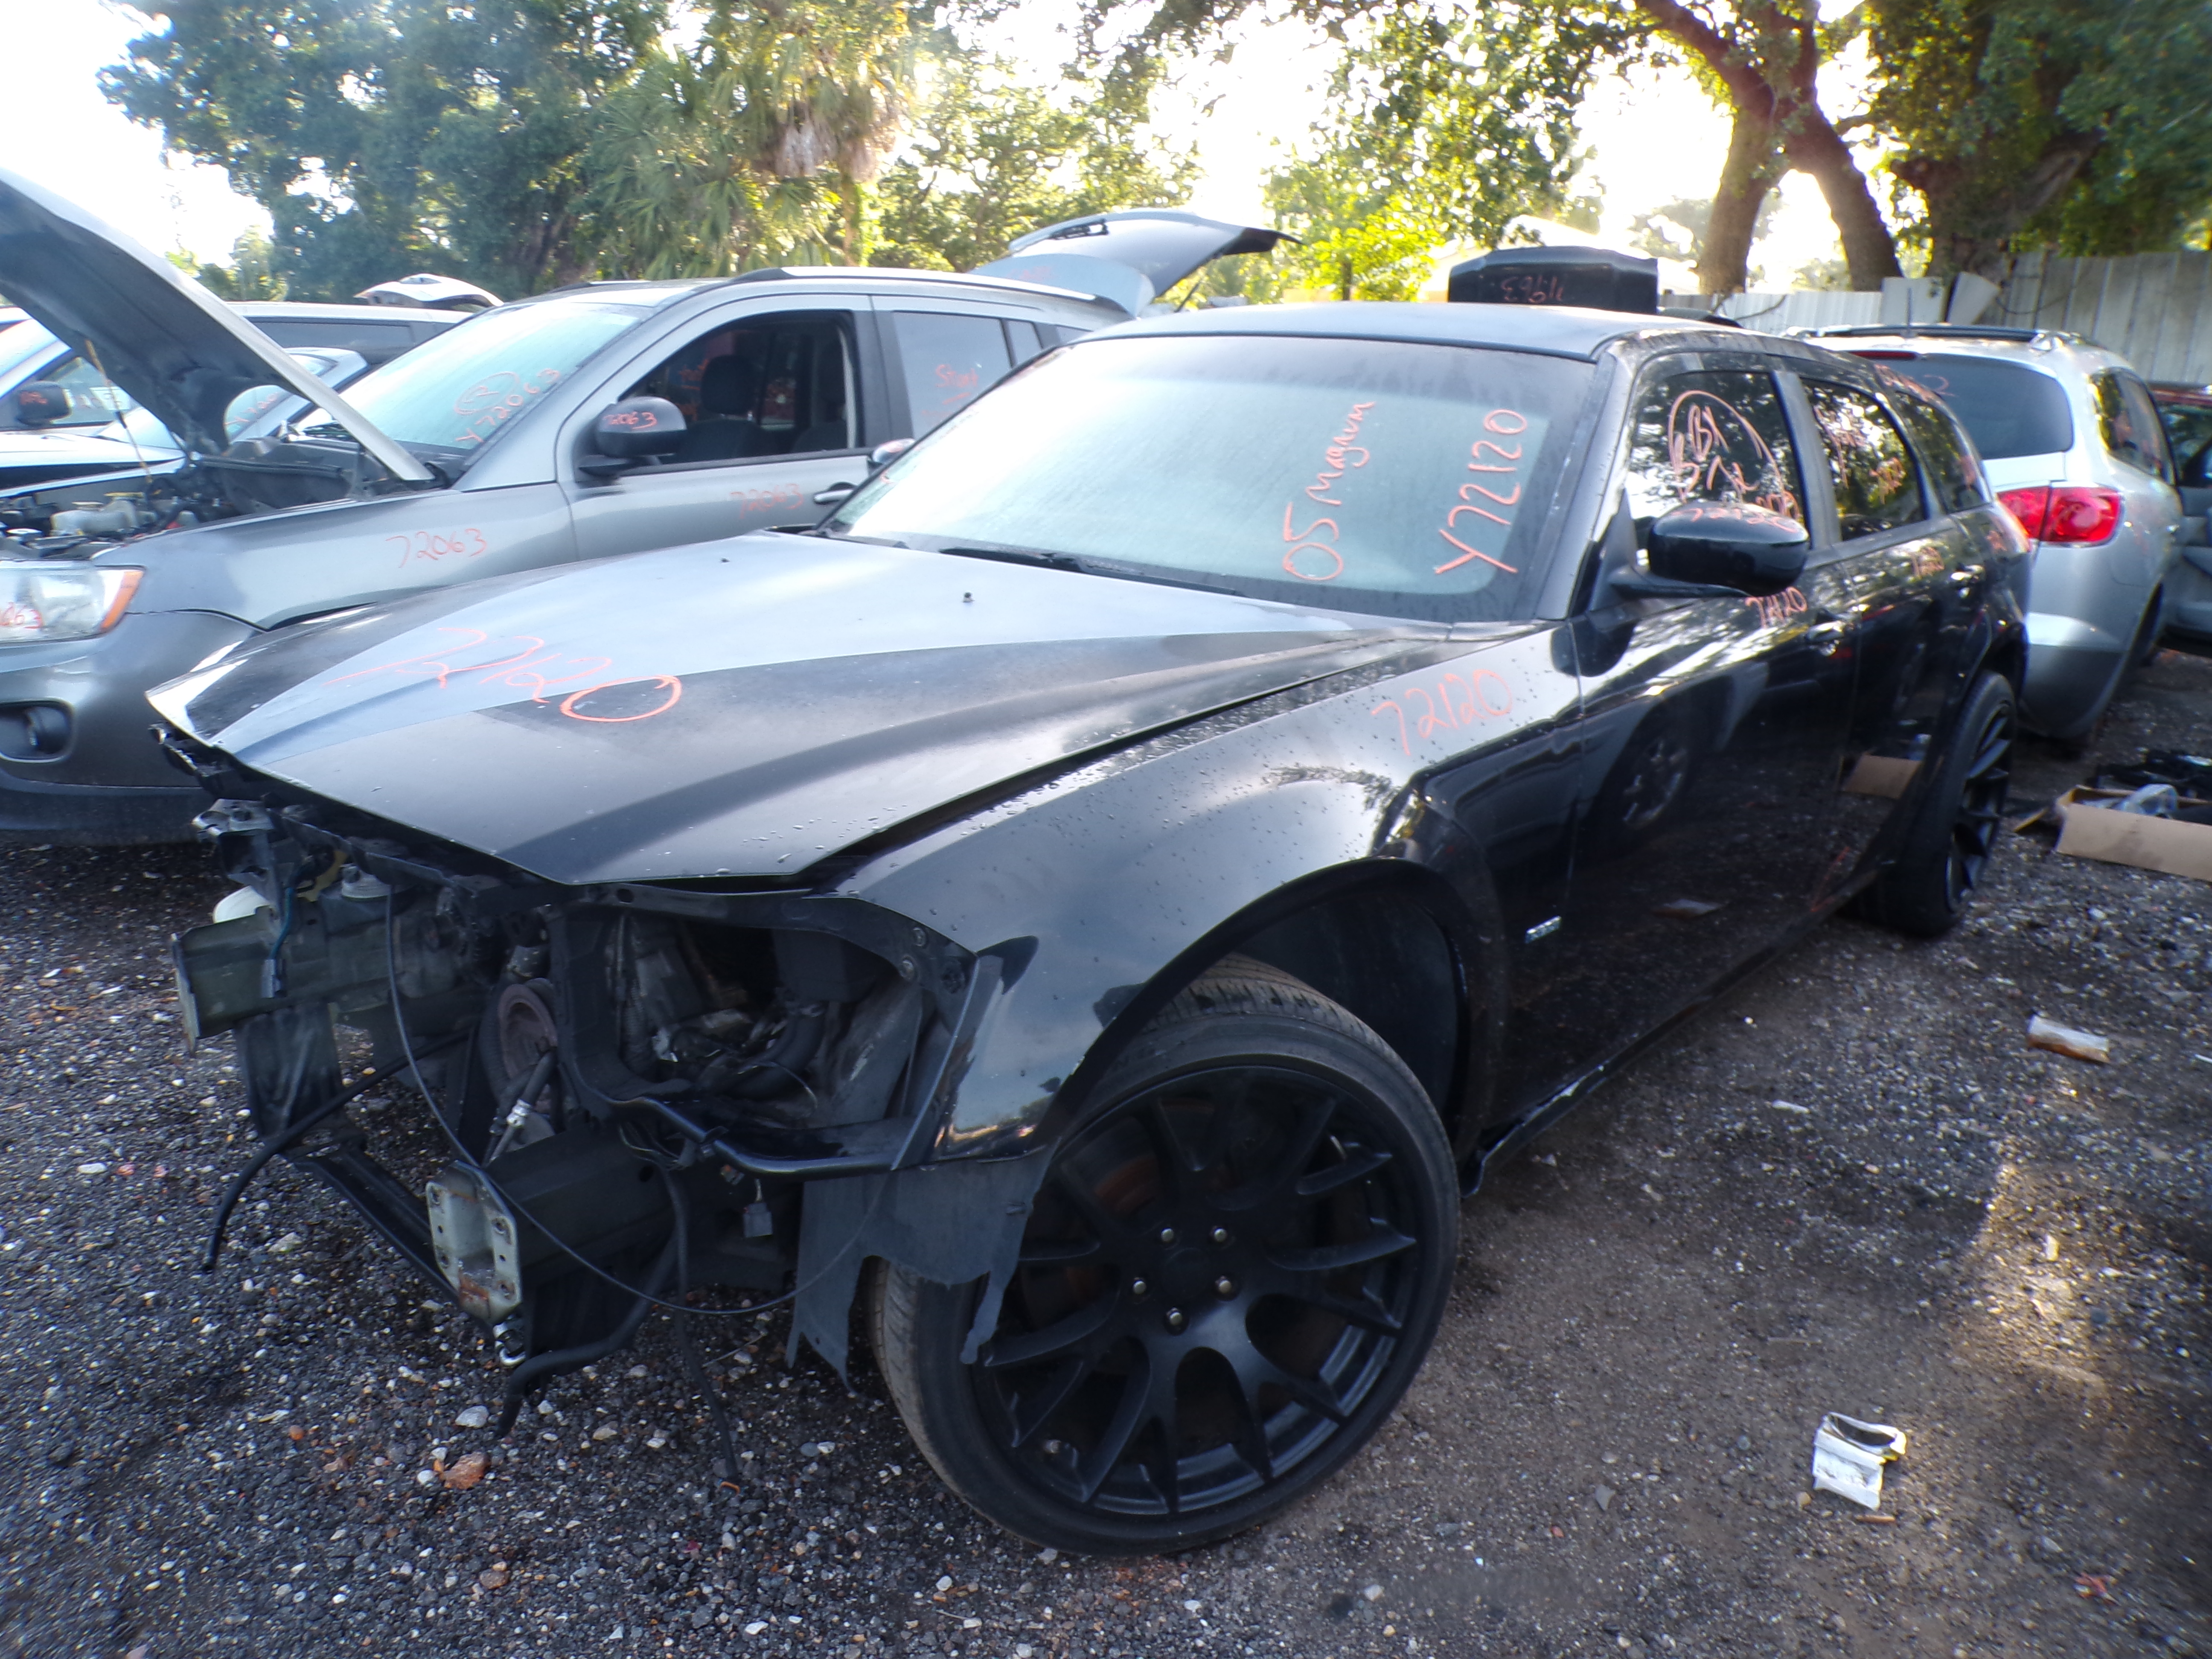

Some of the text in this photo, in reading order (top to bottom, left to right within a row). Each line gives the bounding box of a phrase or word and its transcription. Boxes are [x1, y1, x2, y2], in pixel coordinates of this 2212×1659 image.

[1434, 409, 1528, 575] Y72120
[385, 528, 488, 568] 72063
[1283, 501, 1344, 581] 05
[1370, 669, 1513, 756] 72120
